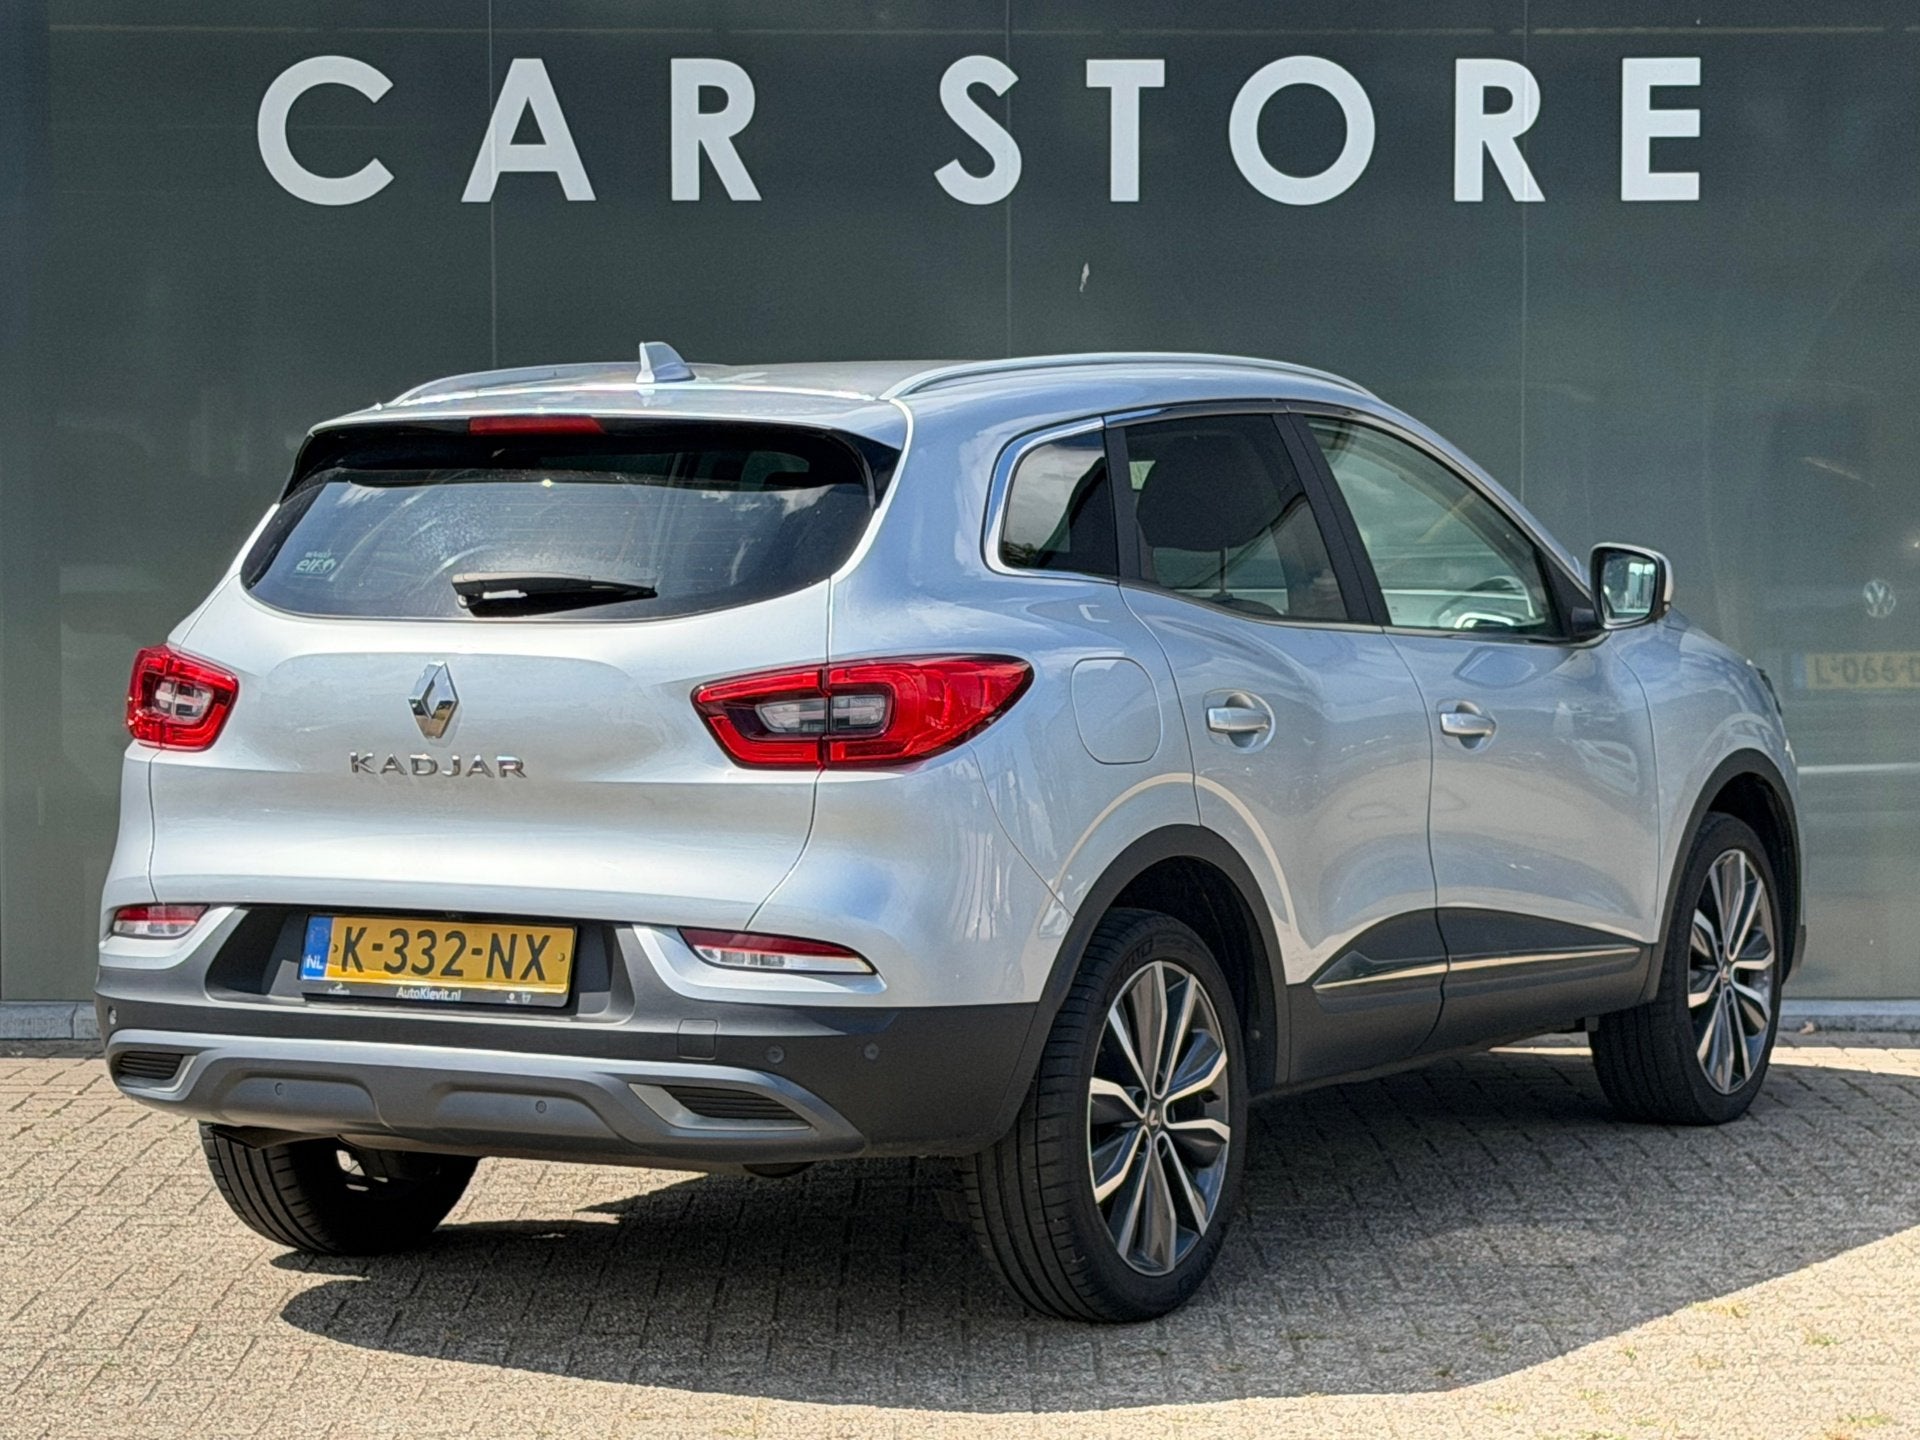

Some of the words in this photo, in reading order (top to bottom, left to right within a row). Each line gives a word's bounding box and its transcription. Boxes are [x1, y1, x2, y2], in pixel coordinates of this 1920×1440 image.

[257, 55, 762, 205] CAR
[933, 55, 1701, 205] STORE
[350, 751, 528, 778] KADJAR
[306, 955, 324, 970] NL
[341, 926, 551, 981] K-332-NX
[396, 985, 462, 1001] AutoKievit.nl
